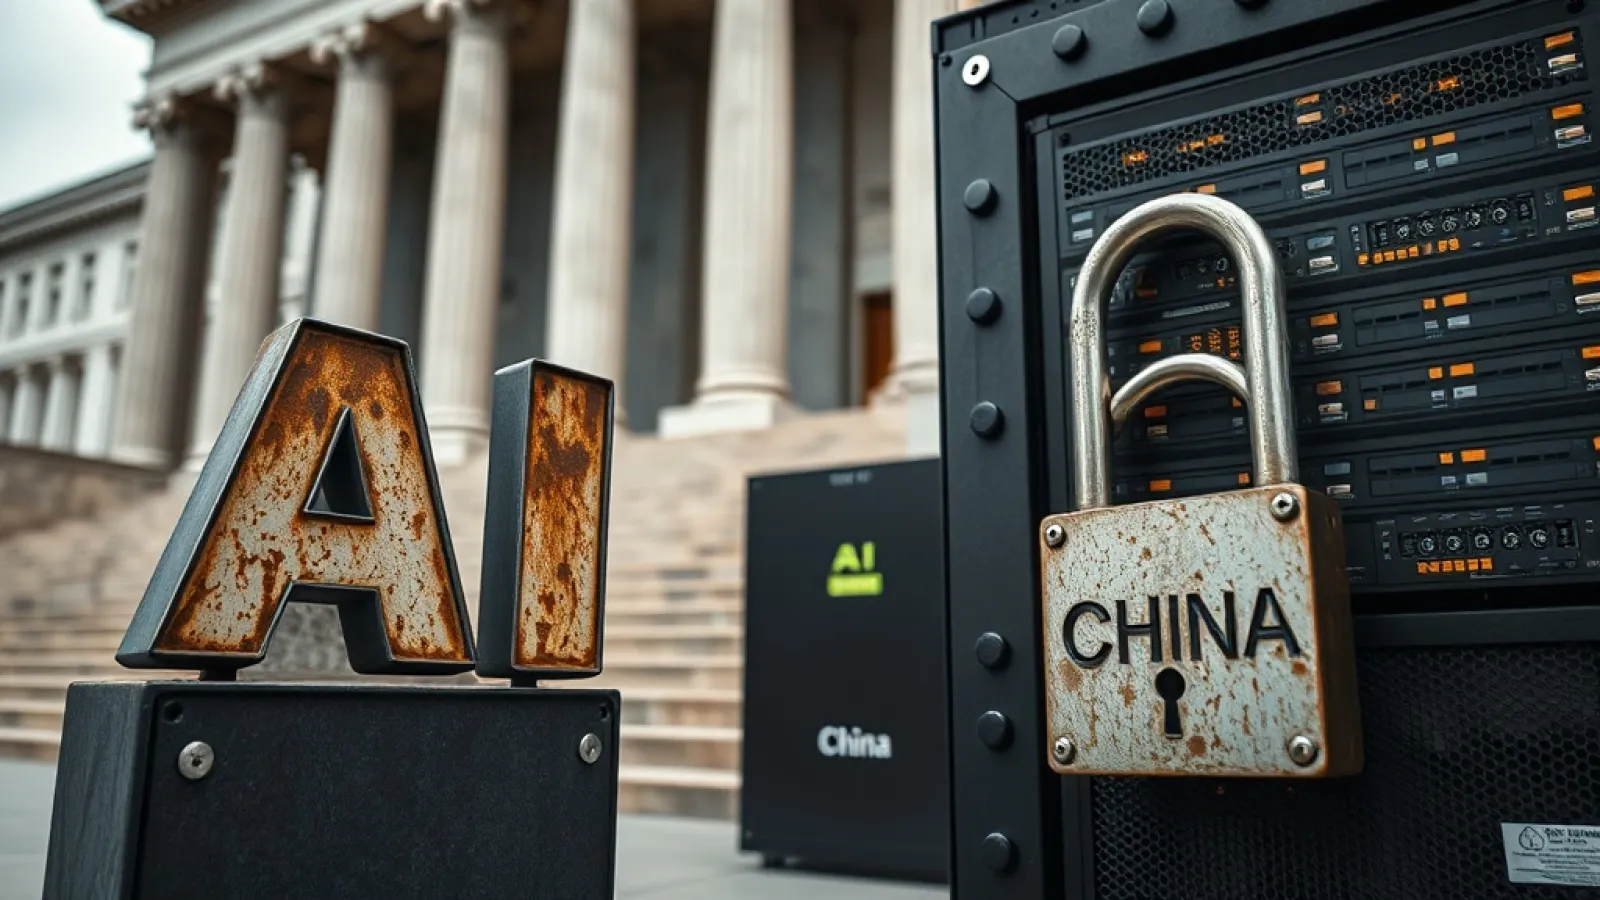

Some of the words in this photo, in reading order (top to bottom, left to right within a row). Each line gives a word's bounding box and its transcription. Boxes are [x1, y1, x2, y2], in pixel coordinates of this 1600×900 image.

[115, 317, 614, 676] AI
[831, 541, 875, 573] AI
[1062, 587, 1302, 668] CHINA
[817, 725, 892, 758] China
